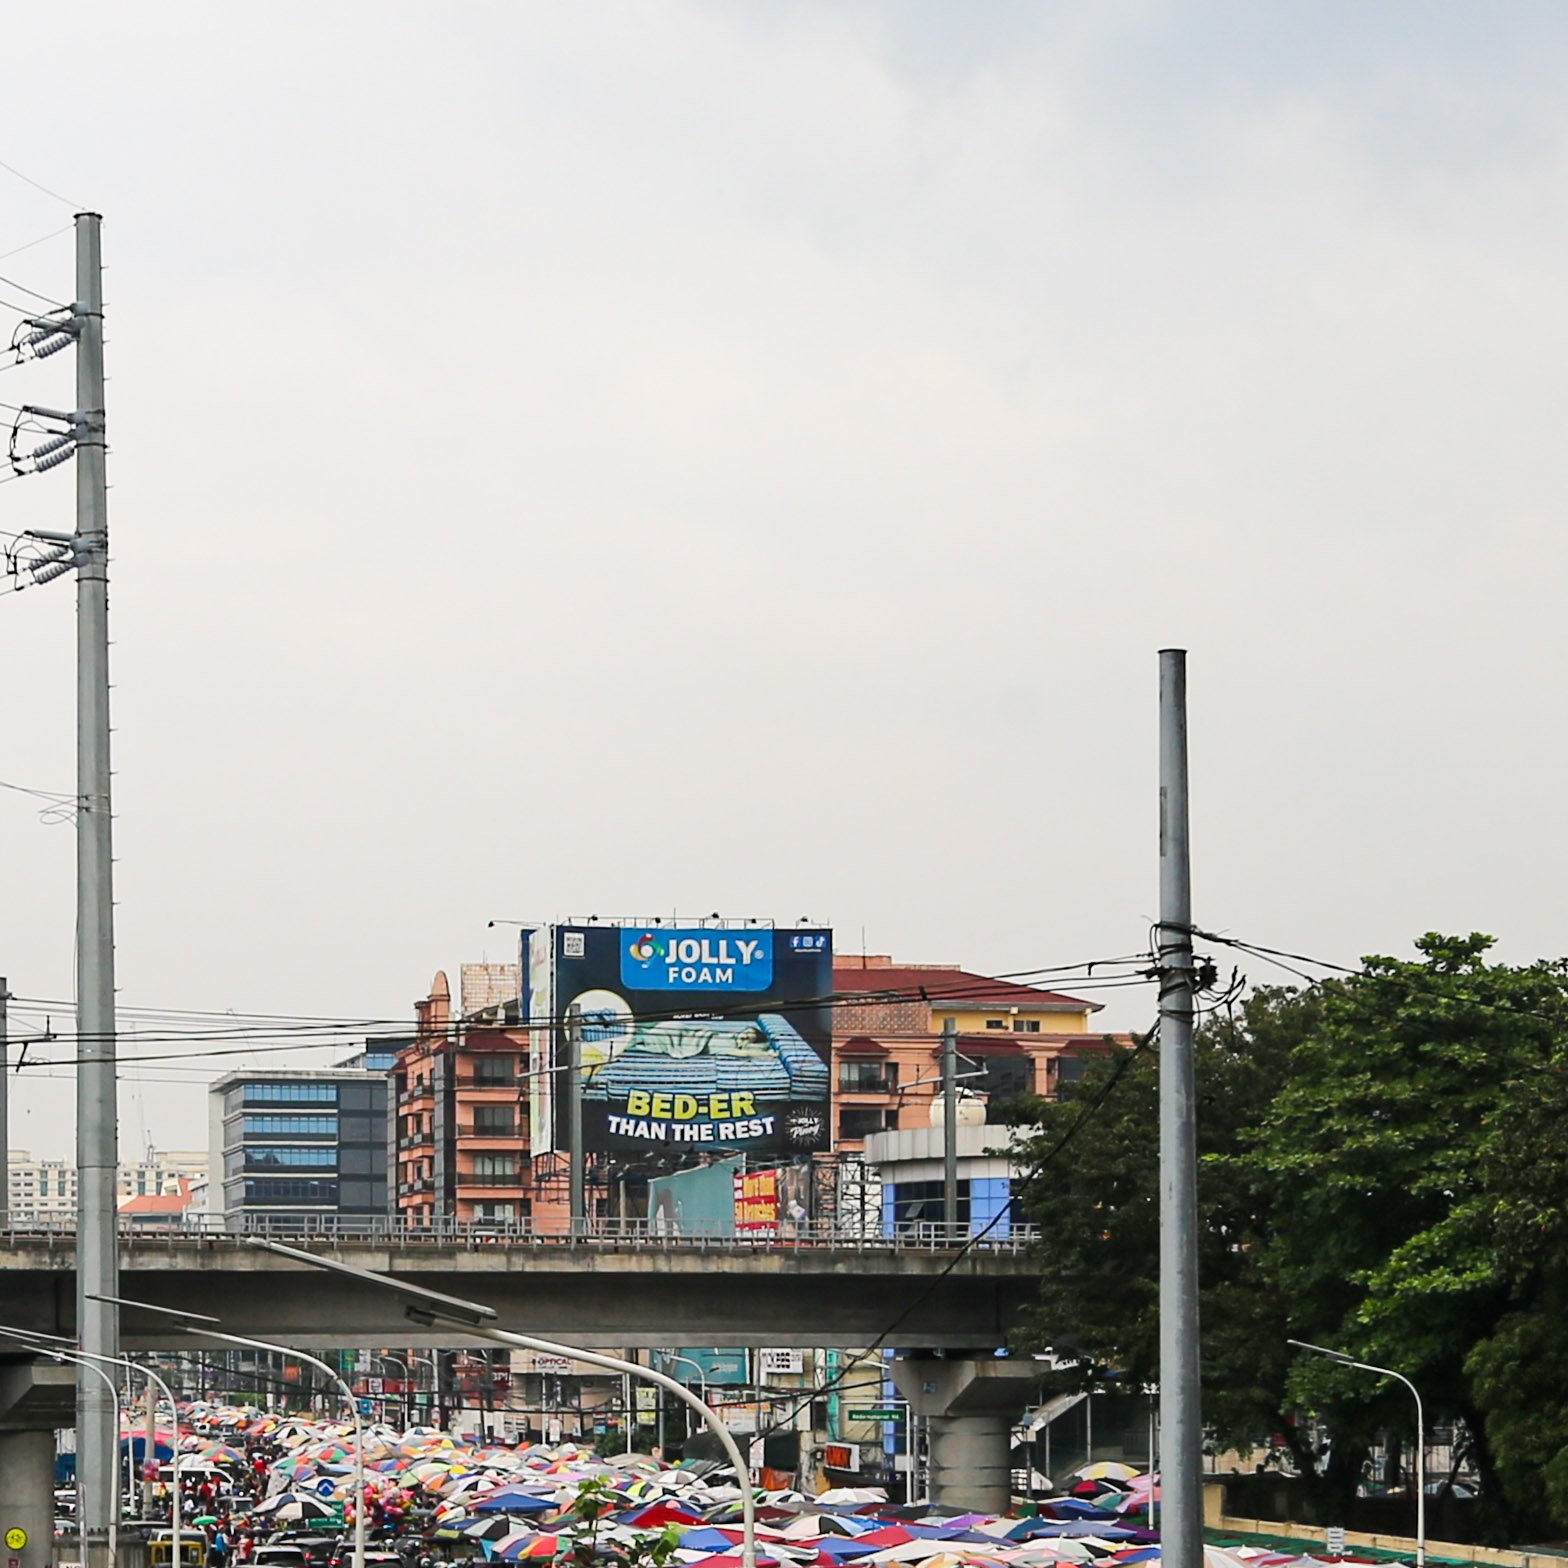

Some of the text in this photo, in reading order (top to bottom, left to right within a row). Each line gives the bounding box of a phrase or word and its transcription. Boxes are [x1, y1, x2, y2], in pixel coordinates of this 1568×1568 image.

[665, 938, 758, 965] JOLLY
[668, 966, 733, 983] FOAM
[626, 1089, 756, 1120] BED-ER
[607, 1115, 775, 1143] THAN THE REST
